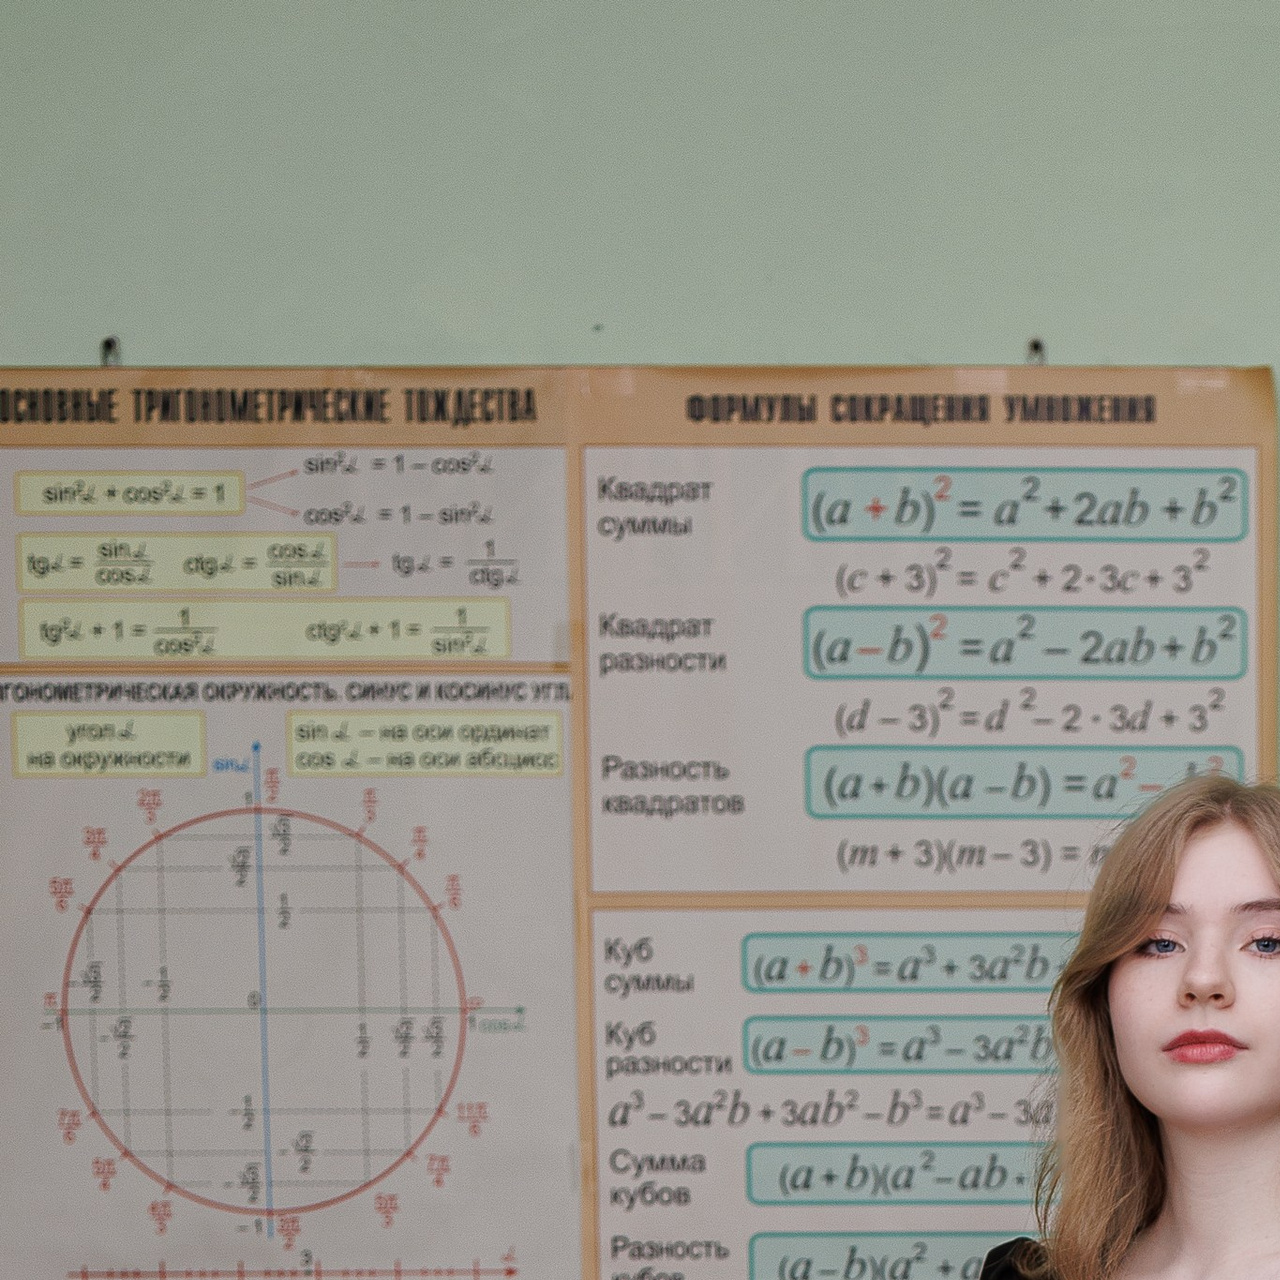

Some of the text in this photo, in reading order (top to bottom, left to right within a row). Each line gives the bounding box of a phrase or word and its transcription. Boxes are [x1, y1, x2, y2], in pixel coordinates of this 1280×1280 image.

[133, 387, 393, 424] ТРИГОНОМЕТРИЧЕСКИЕ
[404, 387, 539, 429] ТОЖДЕСТВА
[686, 393, 816, 424] ФОРМУЛЫ
[1003, 393, 1156, 424] УМНОЖЕНИЯ
[597, 476, 714, 505] Квадрат
[597, 515, 693, 542] суммы
[598, 613, 714, 643] Квадрат
[599, 651, 728, 678] разности
[601, 754, 731, 781] Разность
[601, 793, 746, 818] квадратов
[603, 937, 654, 968] Куб
[603, 973, 695, 999] суммы
[605, 1020, 657, 1051] Куб
[605, 1054, 733, 1080] разности
[608, 1147, 707, 1179] Сумма
[609, 1180, 692, 1213] кубов
[610, 1235, 730, 1261] Разность
